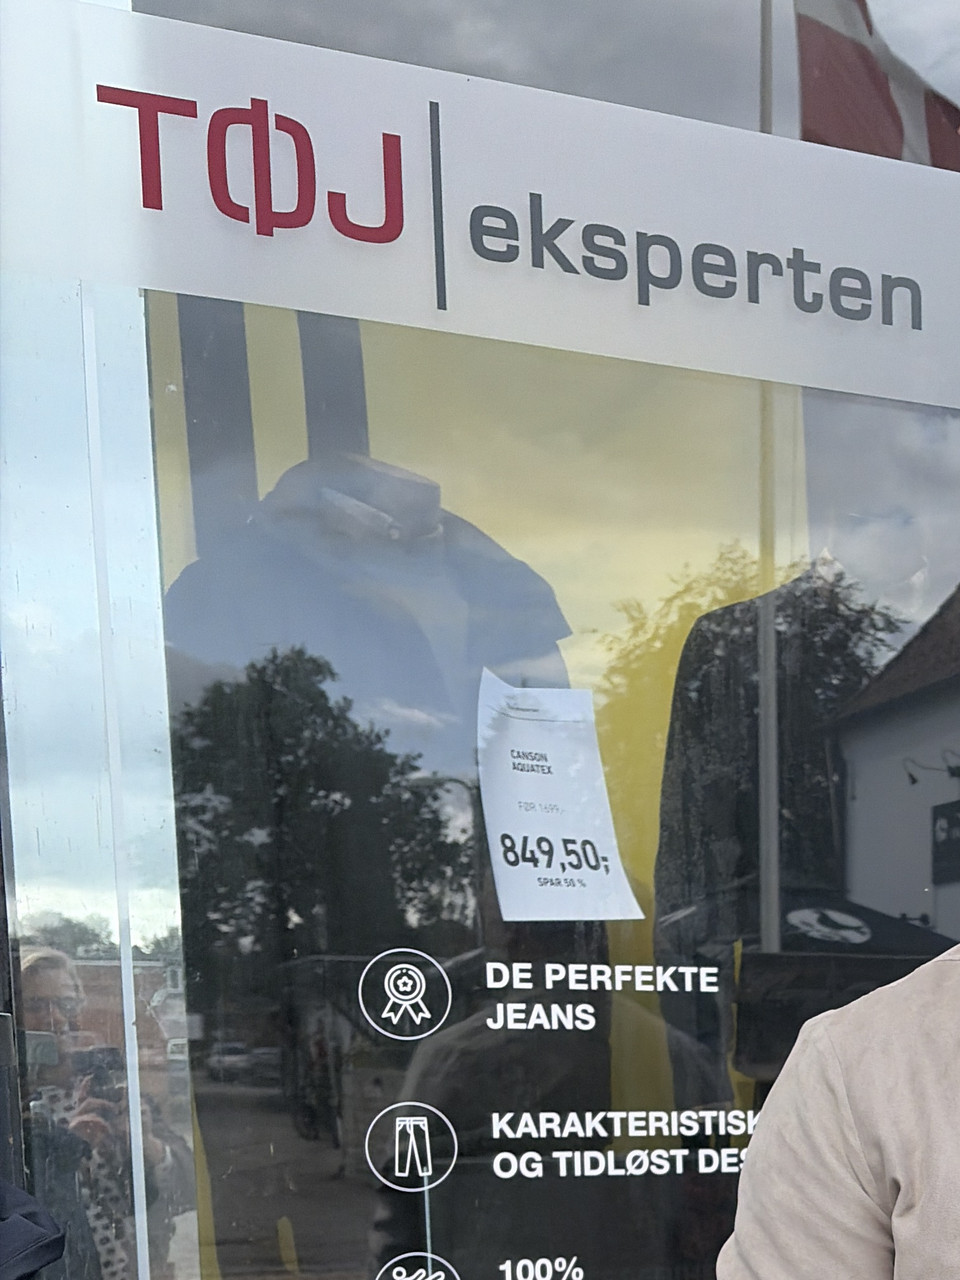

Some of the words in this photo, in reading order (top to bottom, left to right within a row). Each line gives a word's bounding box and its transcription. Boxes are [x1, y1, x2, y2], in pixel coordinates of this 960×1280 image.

[96, 84, 404, 244] TØJ
[469, 193, 924, 331] eksperten
[510, 749, 548, 762] CANSON
[512, 762, 554, 775] AQUATEX
[537, 877, 562, 888] SPAR
[486, 962, 533, 989] DE
[545, 963, 719, 993] PERFEKTE
[486, 1003, 596, 1031] JEANS
[493, 1151, 543, 1178] OG
[552, 1148, 689, 1178] TIDLØST
